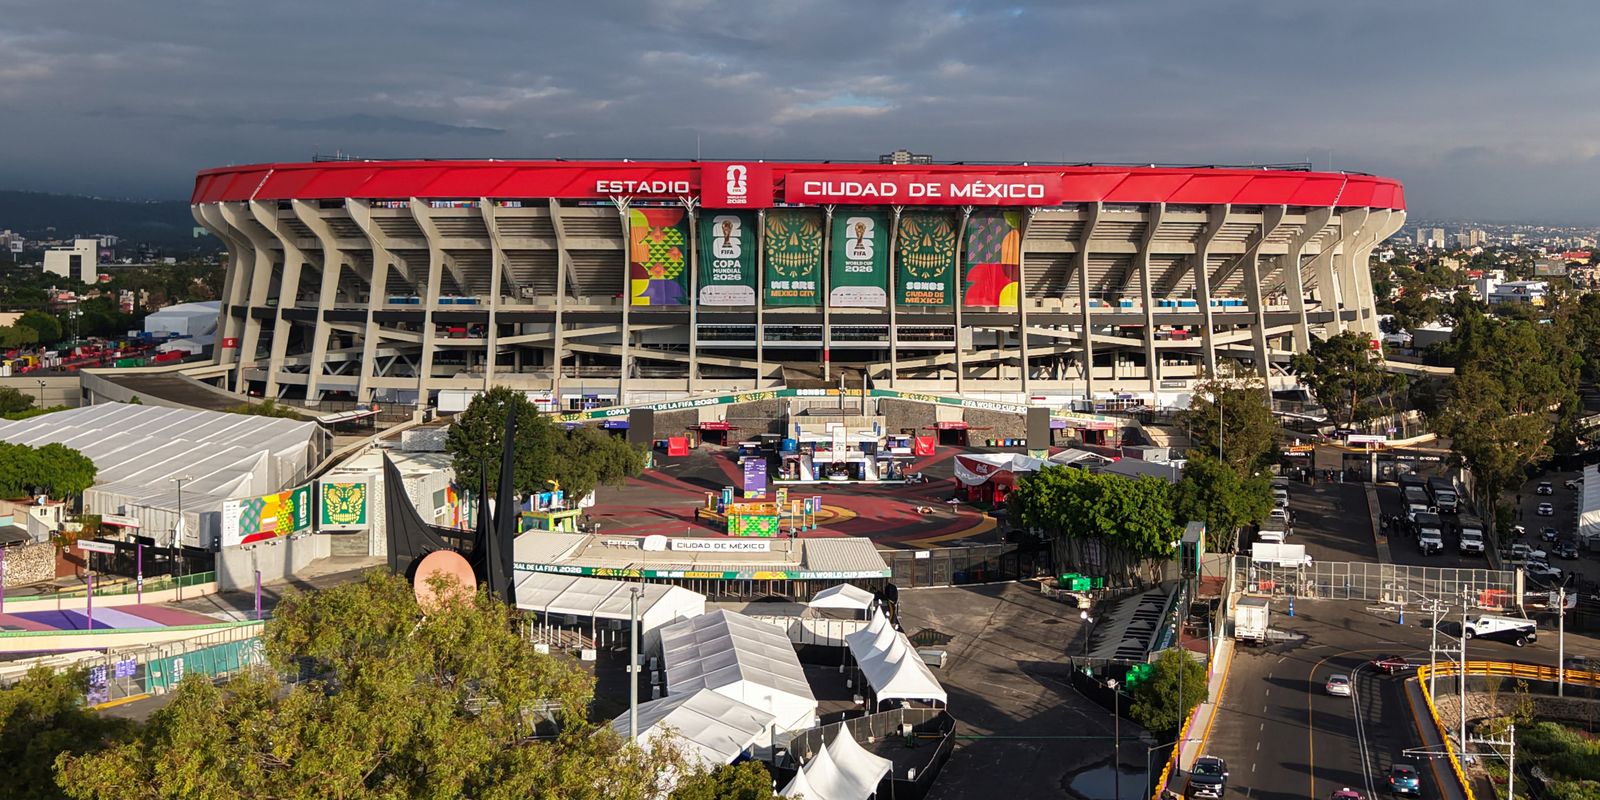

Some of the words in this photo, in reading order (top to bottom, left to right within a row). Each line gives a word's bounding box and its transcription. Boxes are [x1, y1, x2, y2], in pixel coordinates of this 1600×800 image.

[596, 180, 689, 193] ESTADIO
[804, 181, 897, 196] CIUDAD
[909, 183, 941, 197] DE
[950, 180, 1044, 198] MÉXICO
[713, 260, 741, 268] COPA
[713, 273, 741, 281] 2026
[770, 281, 790, 290] WE
[791, 281, 815, 290] ARE
[905, 281, 944, 291] SOMOS
[694, 398, 719, 406] 2026
[977, 401, 1001, 410] WORLD
[1002, 404, 1015, 412] CUP
[729, 541, 765, 550] MÉXICO
[558, 566, 582, 574] 2026
[799, 571, 816, 579] FIFA
[816, 571, 842, 579] WORLD
